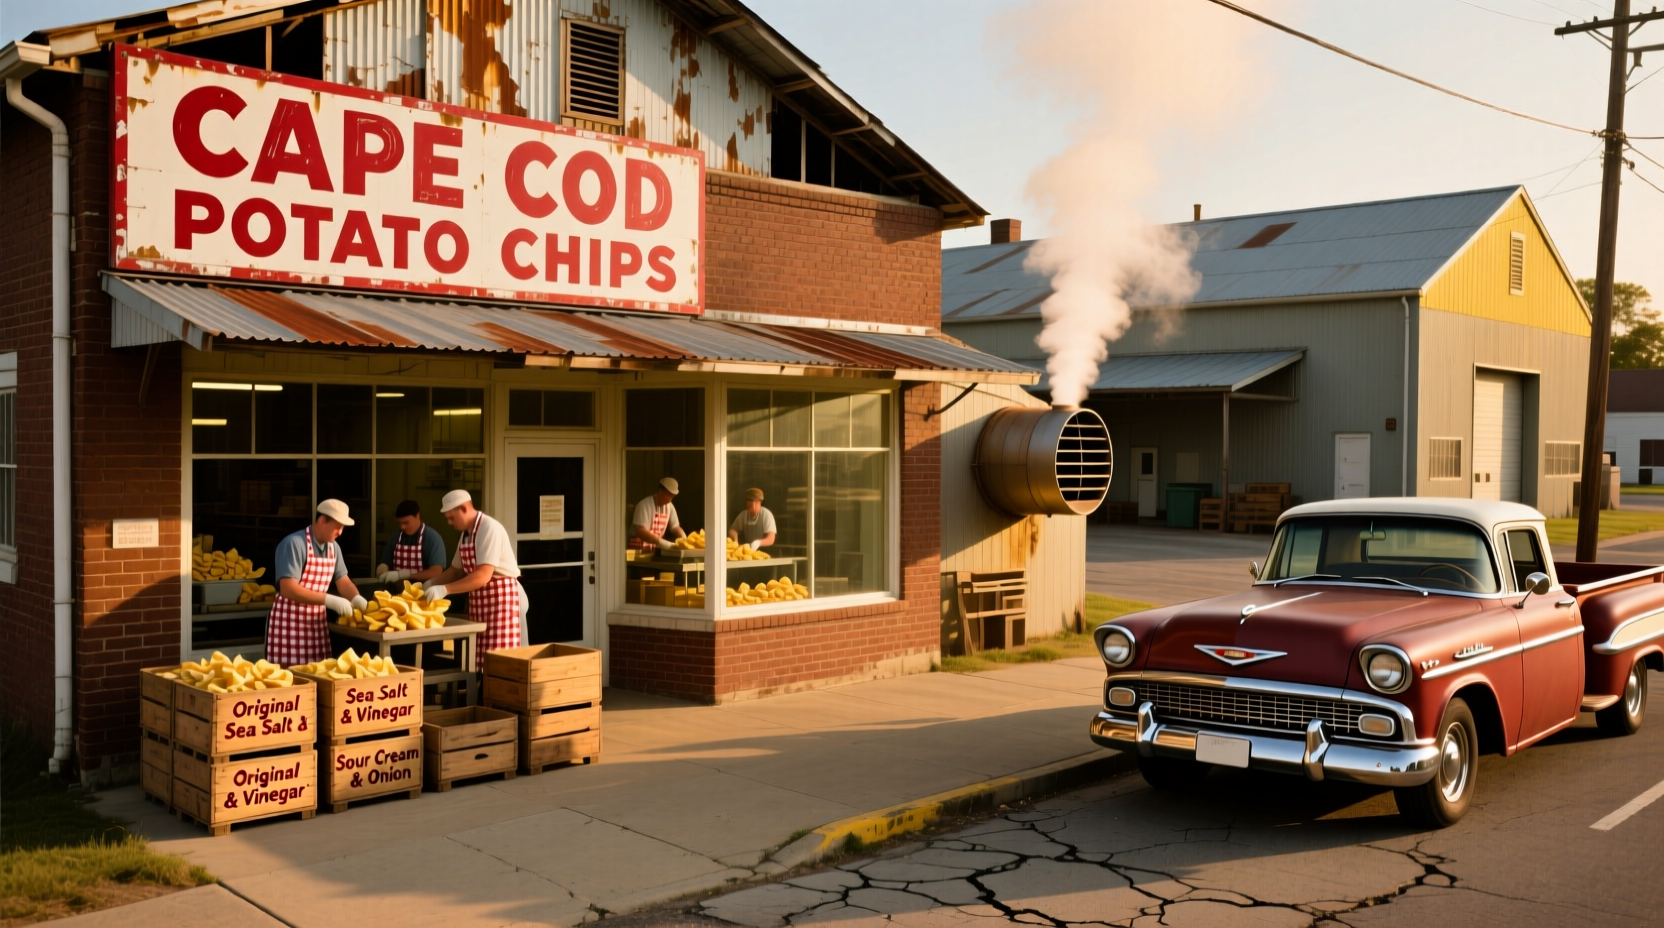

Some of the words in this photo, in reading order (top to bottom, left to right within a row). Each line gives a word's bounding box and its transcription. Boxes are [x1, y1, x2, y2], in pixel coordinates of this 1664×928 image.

[172, 86, 463, 208] CAPE
[505, 141, 672, 230] COD
[174, 189, 470, 274] POTATO
[501, 228, 677, 292] CHIPS
[345, 687, 374, 705] Sea
[377, 682, 408, 701] Salt
[233, 695, 300, 720] Original
[340, 708, 352, 725] &
[356, 705, 415, 722] Vinegar
[224, 721, 256, 740] Sea
[261, 716, 293, 736] Salt
[336, 754, 371, 771] Sour
[374, 748, 419, 766] Cream
[233, 762, 300, 788] Original
[350, 771, 363, 789] &
[368, 766, 411, 784] Onion
[223, 791, 238, 809] &
[243, 788, 305, 805] Vinegar
